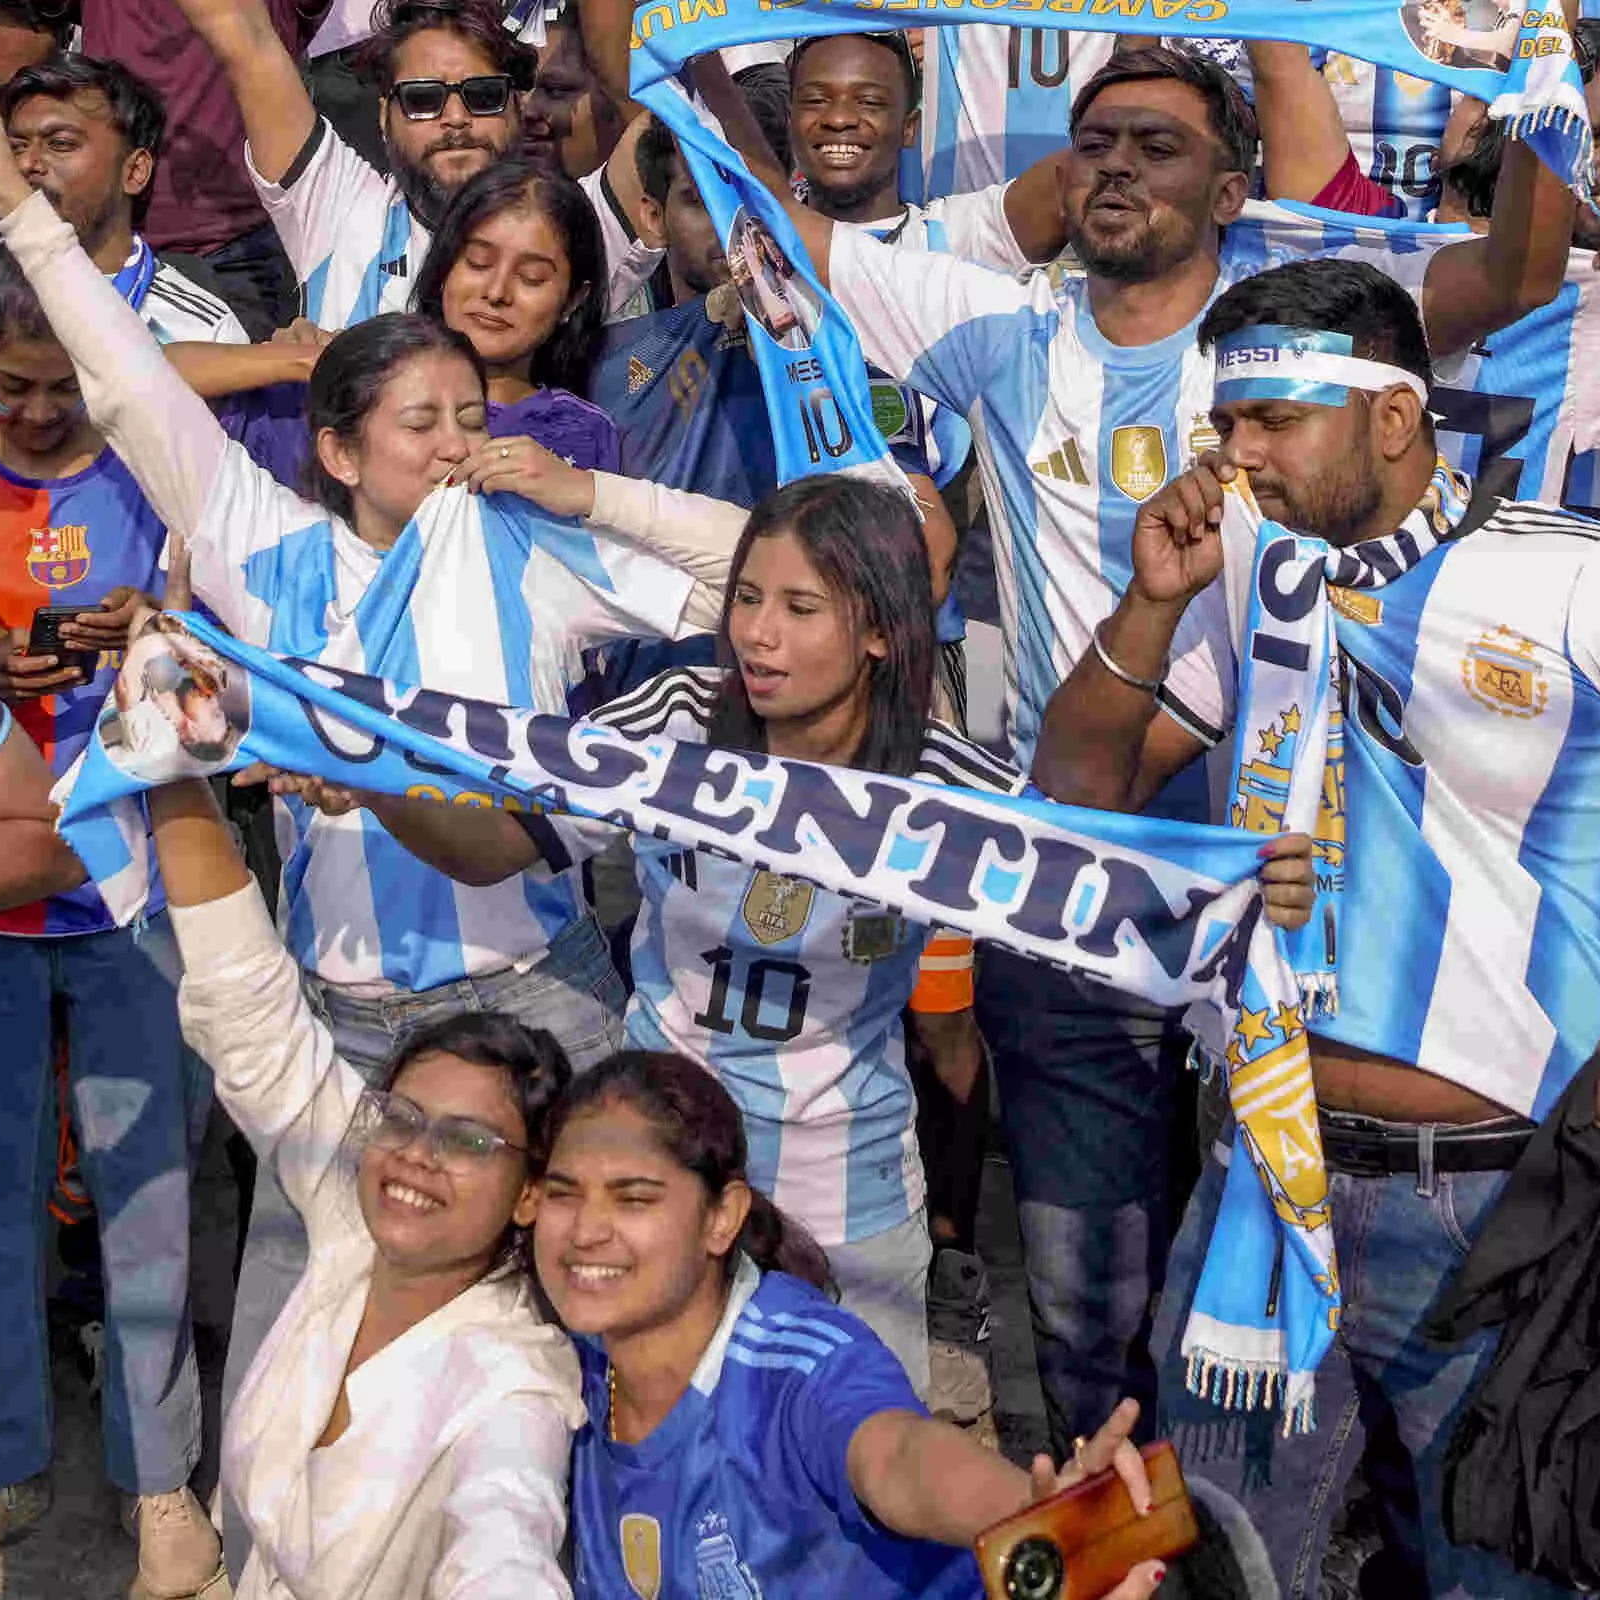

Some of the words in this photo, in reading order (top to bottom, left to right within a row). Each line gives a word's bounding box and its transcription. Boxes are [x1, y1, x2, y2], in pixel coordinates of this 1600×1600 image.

[1518, 36, 1564, 60] DEL
[783, 362, 824, 386] MES
[799, 388, 854, 466] 10
[694, 945, 811, 1044] 10
